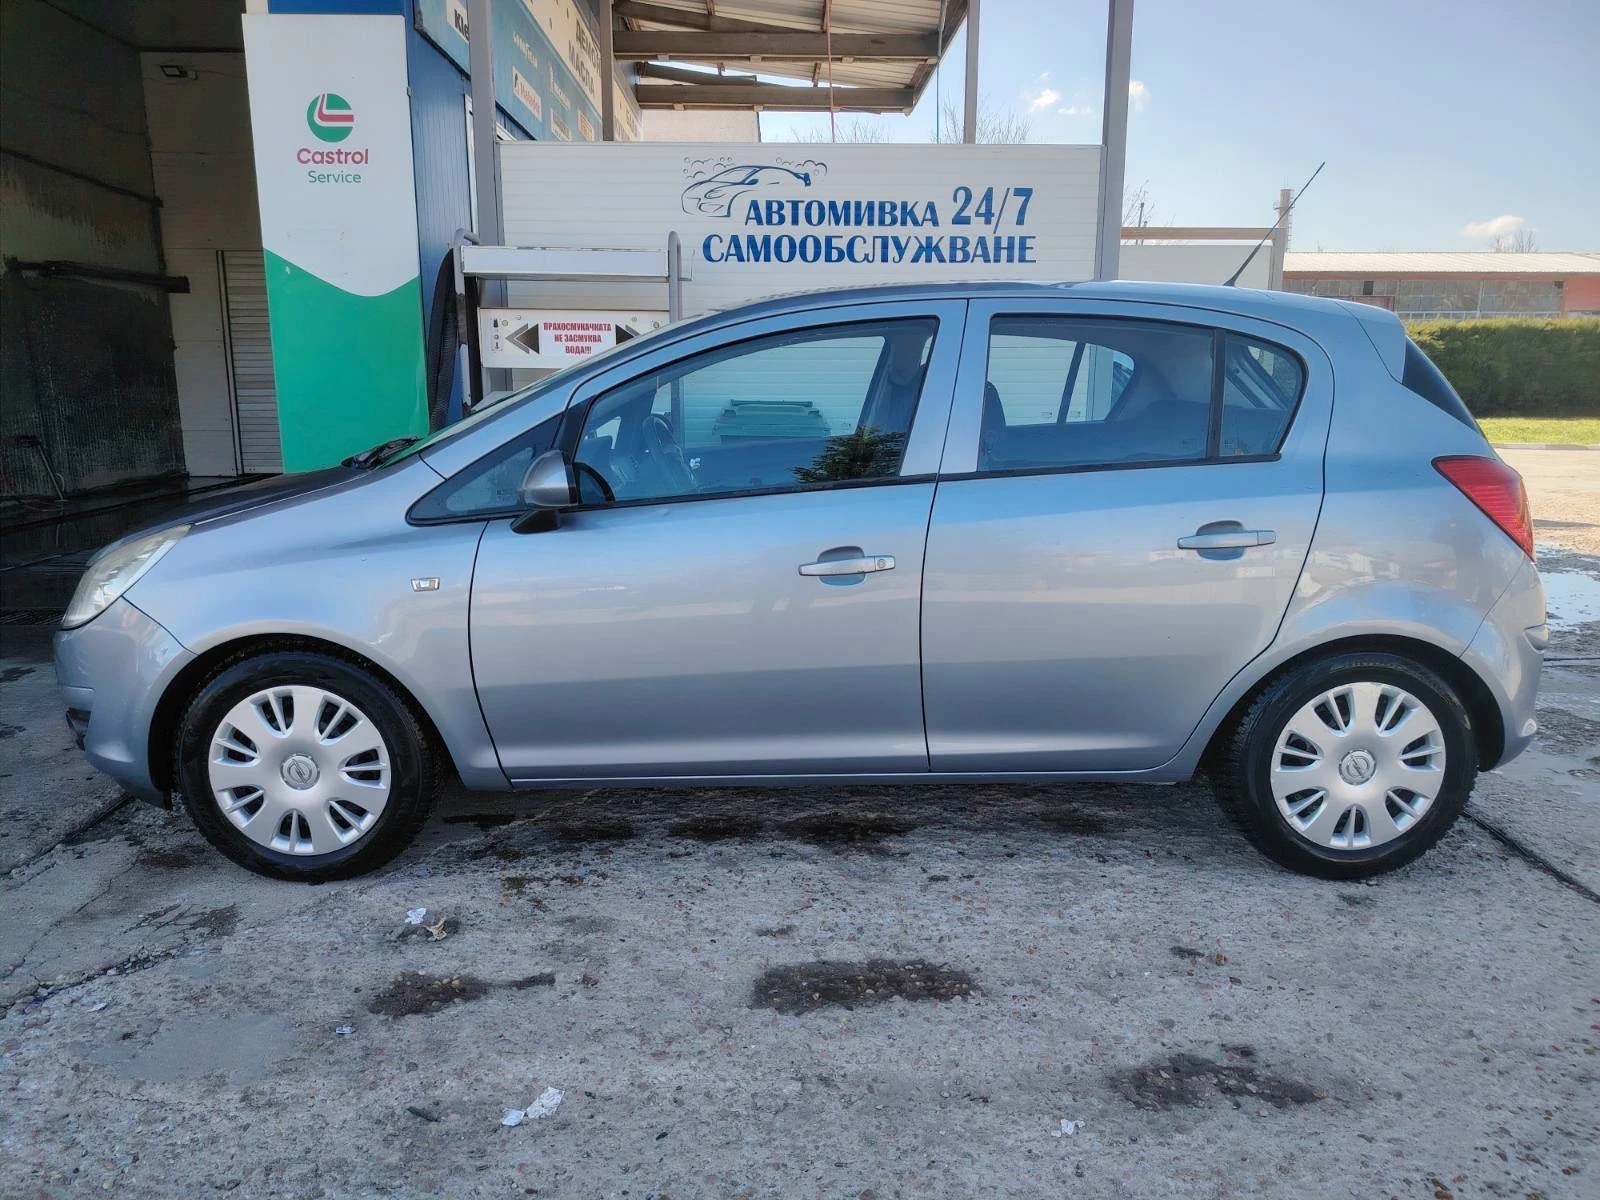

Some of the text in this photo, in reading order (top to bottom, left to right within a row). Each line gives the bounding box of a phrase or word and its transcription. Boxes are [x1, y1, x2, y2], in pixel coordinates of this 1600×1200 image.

[297, 148, 369, 165] Castrol
[308, 170, 362, 184] Service
[745, 186, 1034, 234] АВТОМИВКА 24/7
[702, 234, 1037, 264] САМООБСЛУЖВАНЕ
[554, 334, 602, 343] НЕ ЗАСМУКВА
[565, 345, 592, 356] ВОДА!!!
